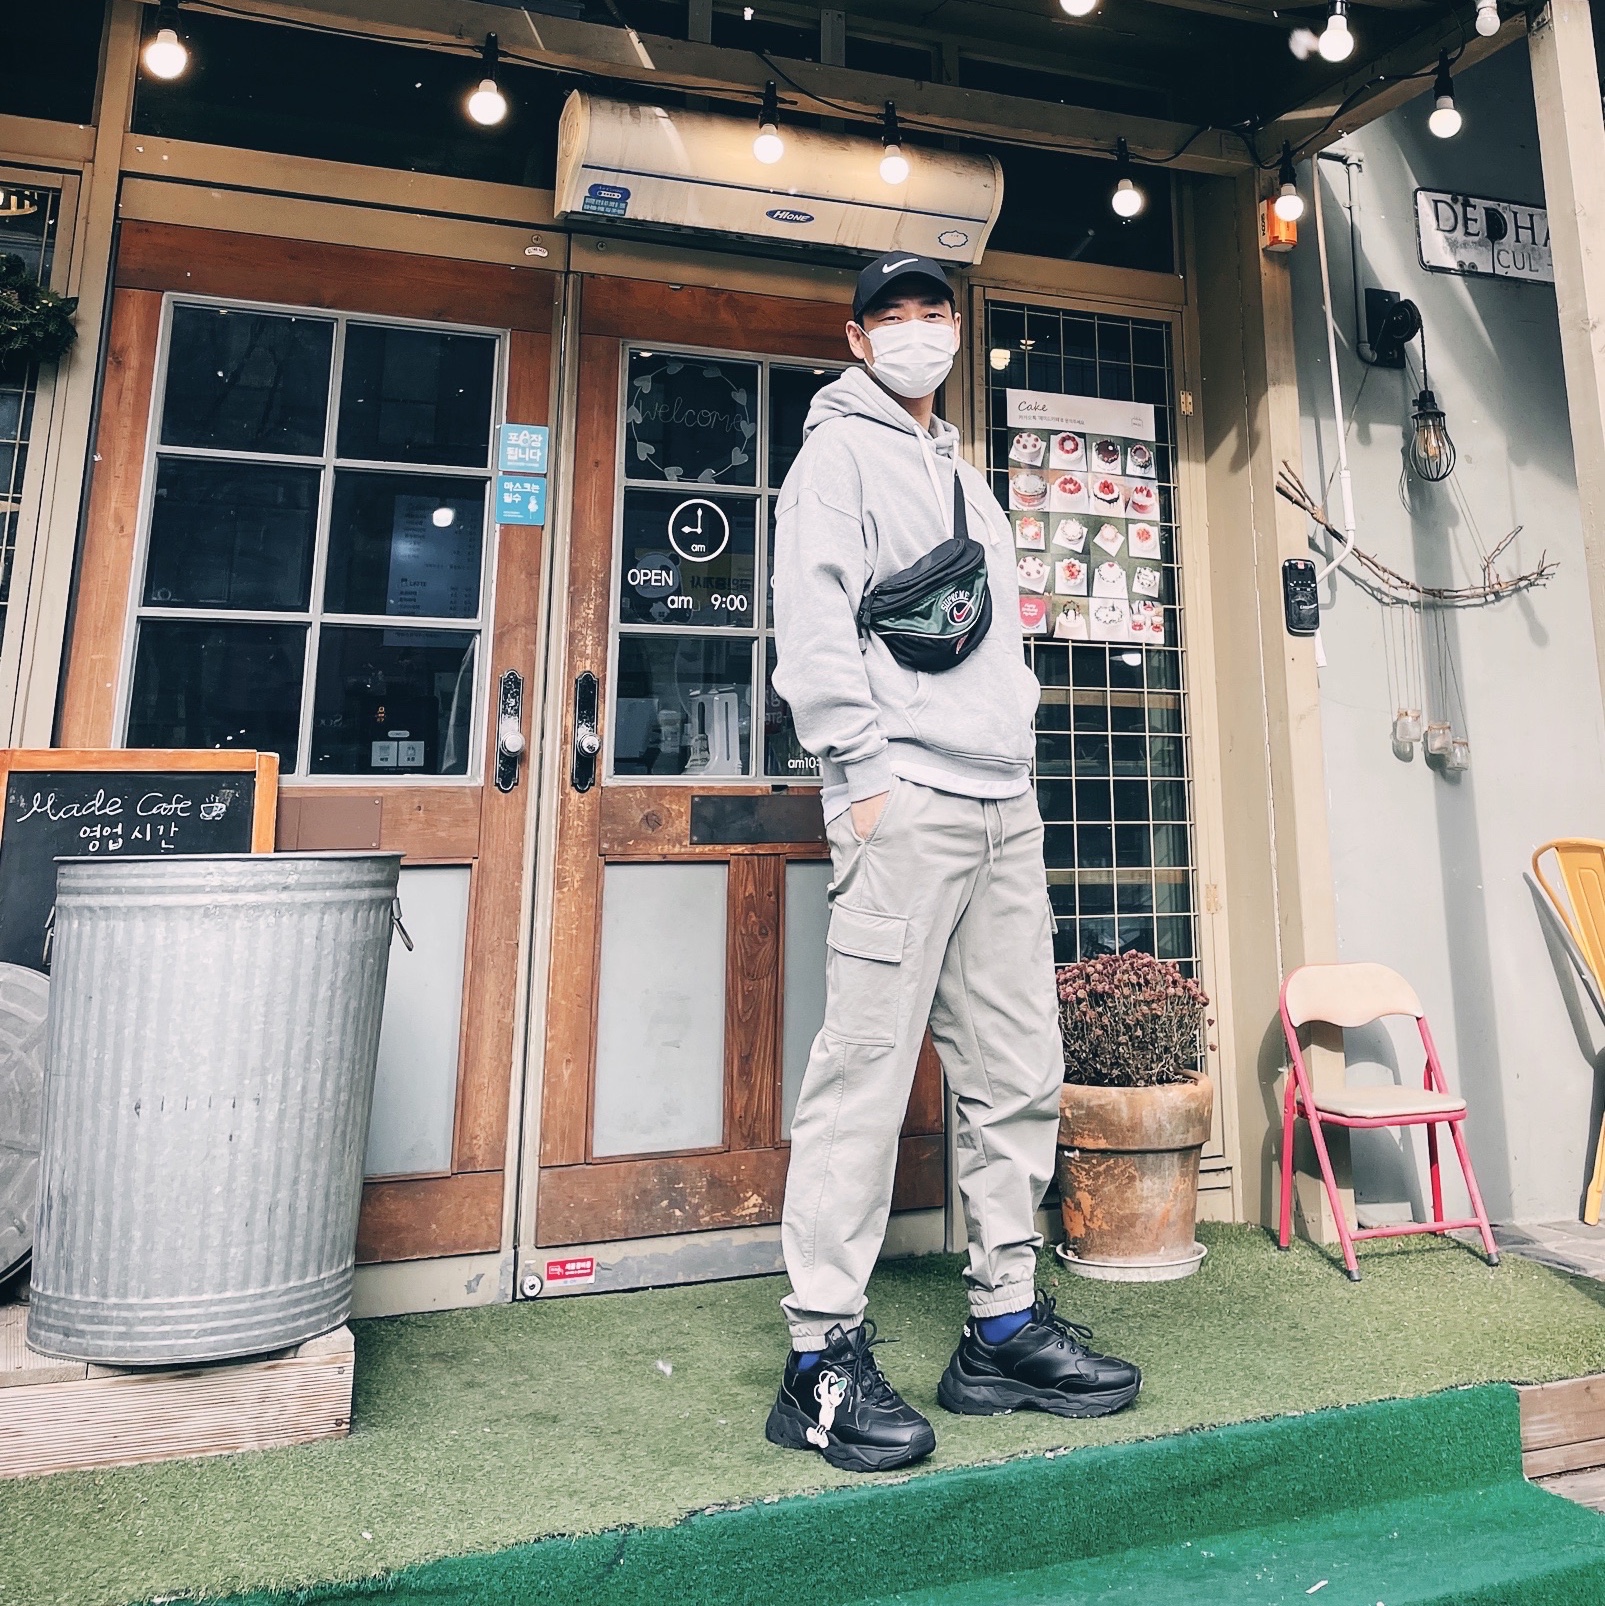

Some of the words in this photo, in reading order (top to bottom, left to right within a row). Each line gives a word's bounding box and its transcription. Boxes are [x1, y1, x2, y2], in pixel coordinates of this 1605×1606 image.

[1018, 400, 1048, 412] Cake
[506, 447, 542, 462] 됩니다
[503, 481, 540, 493] 마스크는
[503, 492, 522, 504] 필수
[690, 543, 706, 553] am
[627, 568, 673, 587] OPEN
[667, 595, 693, 609] am
[711, 593, 748, 612] 9:00
[940, 590, 970, 612] SUPREME
[16, 789, 124, 823] Made
[136, 792, 192, 817] Cafe
